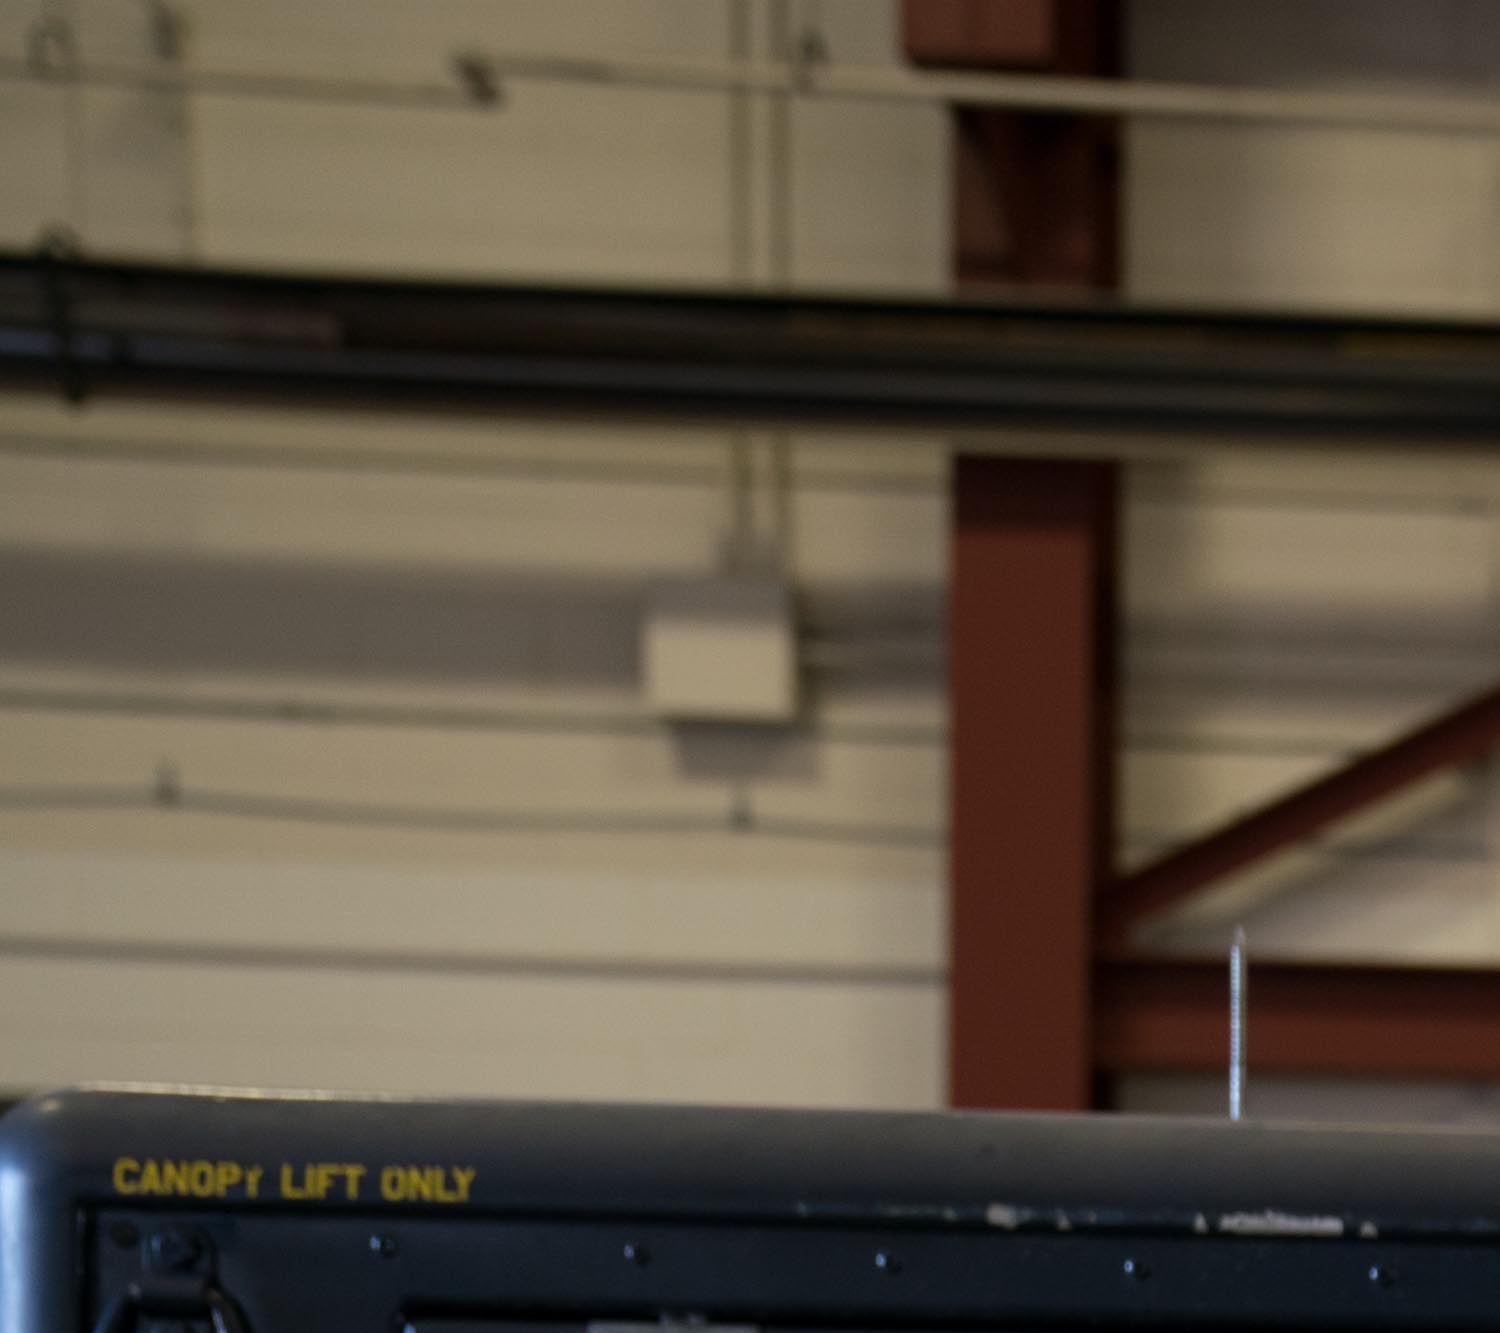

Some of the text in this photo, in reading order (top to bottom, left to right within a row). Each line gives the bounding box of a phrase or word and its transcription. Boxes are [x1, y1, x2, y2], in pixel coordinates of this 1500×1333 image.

[113, 1157, 475, 1203] CANOPY LIFT ONLY
